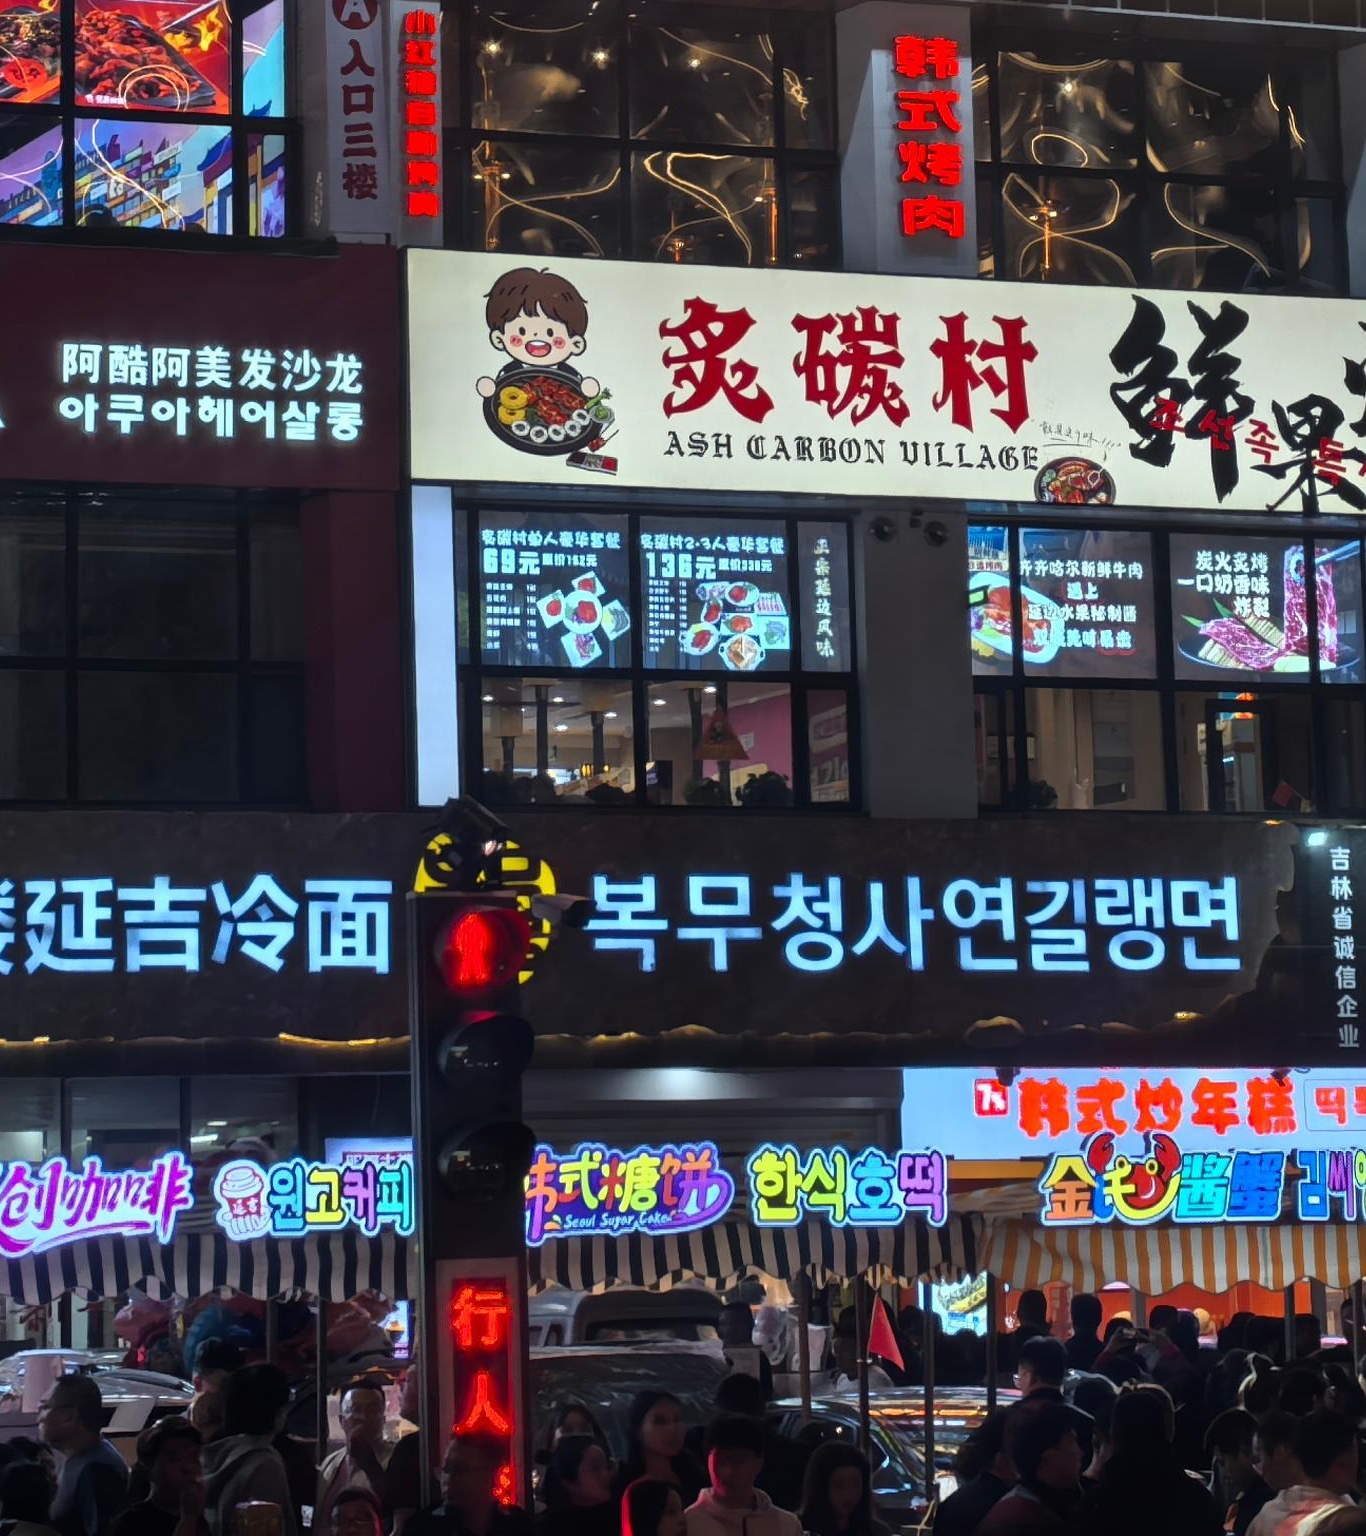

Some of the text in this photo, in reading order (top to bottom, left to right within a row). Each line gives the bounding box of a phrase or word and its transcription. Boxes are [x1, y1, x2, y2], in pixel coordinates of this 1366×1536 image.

[894, 35, 964, 239] 韩式烤肉
[61, 342, 364, 395] 阿酷阿美发沙龙
[658, 295, 1039, 434] 炙碳村
[58, 394, 364, 443] 아쿠아헤어살롱
[663, 431, 1040, 471] ASH CARBON VILLAGE
[482, 548, 541, 576] 69元
[584, 873, 1241, 973] 복무청사연길랭면
[1329, 845, 1361, 1049] 吉林省诚信企业
[1017, 1076, 1297, 1138] 韩式炒年糕
[267, 1160, 414, 1237] 원고커피
[752, 1148, 947, 1227] 한식호떡
[450, 1286, 508, 1438] 行人
